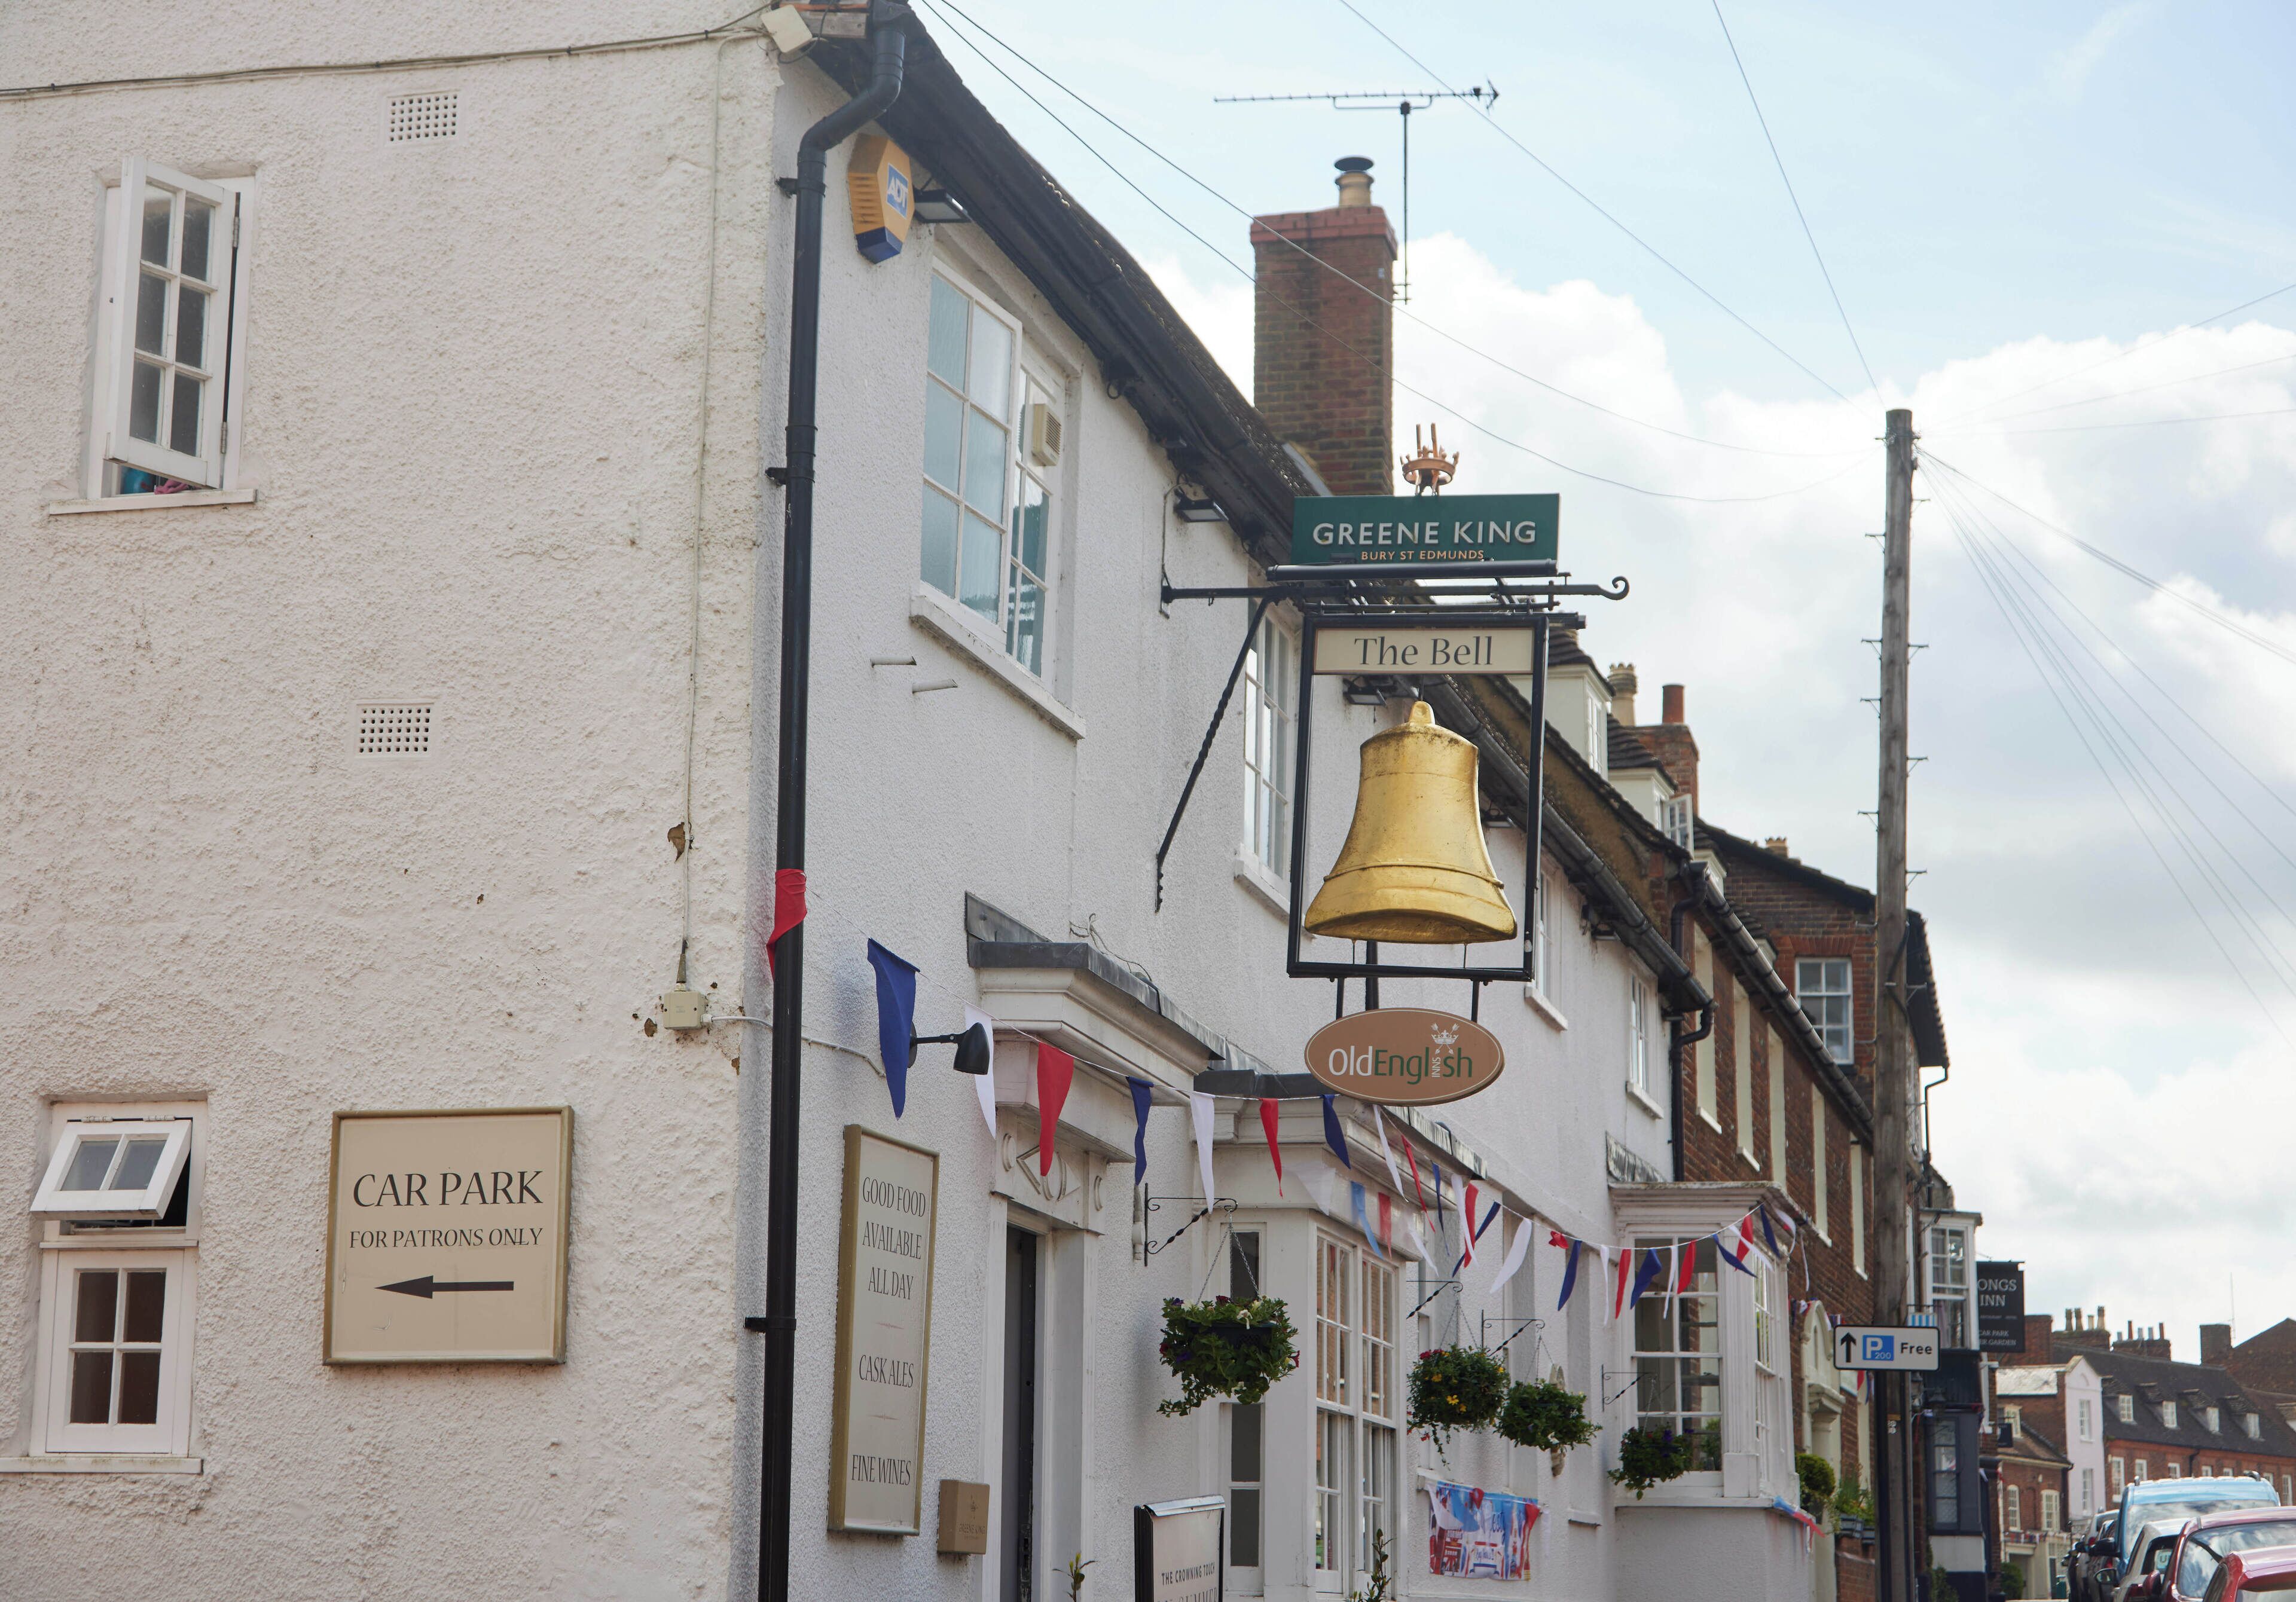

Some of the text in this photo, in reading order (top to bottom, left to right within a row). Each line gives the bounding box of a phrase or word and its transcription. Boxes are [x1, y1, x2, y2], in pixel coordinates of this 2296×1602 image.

[888, 176, 908, 207] ADT
[1312, 521, 1537, 546] GREENE KING
[1361, 550, 1484, 561] BURY ST EDMUNDS
[1354, 635, 1493, 666] The Bell
[1431, 1057, 1442, 1078] INNS
[353, 1170, 544, 1207] CAR PARK
[862, 1176, 926, 1217] GOOD FOOD
[350, 1227, 544, 1248] FOR PATRONS ONLY
[862, 1221, 922, 1259] AVAILABLE
[868, 1267, 914, 1300] ALL DAY
[1977, 1279, 2017, 1291] ONGS
[1980, 1294, 2006, 1307] INN
[1900, 1343, 1932, 1355] Free
[859, 1355, 914, 1388] CASK ALES
[851, 1454, 911, 1485] FINE WINES
[1161, 1562, 1216, 1586] THE CROWNING TOUCH
